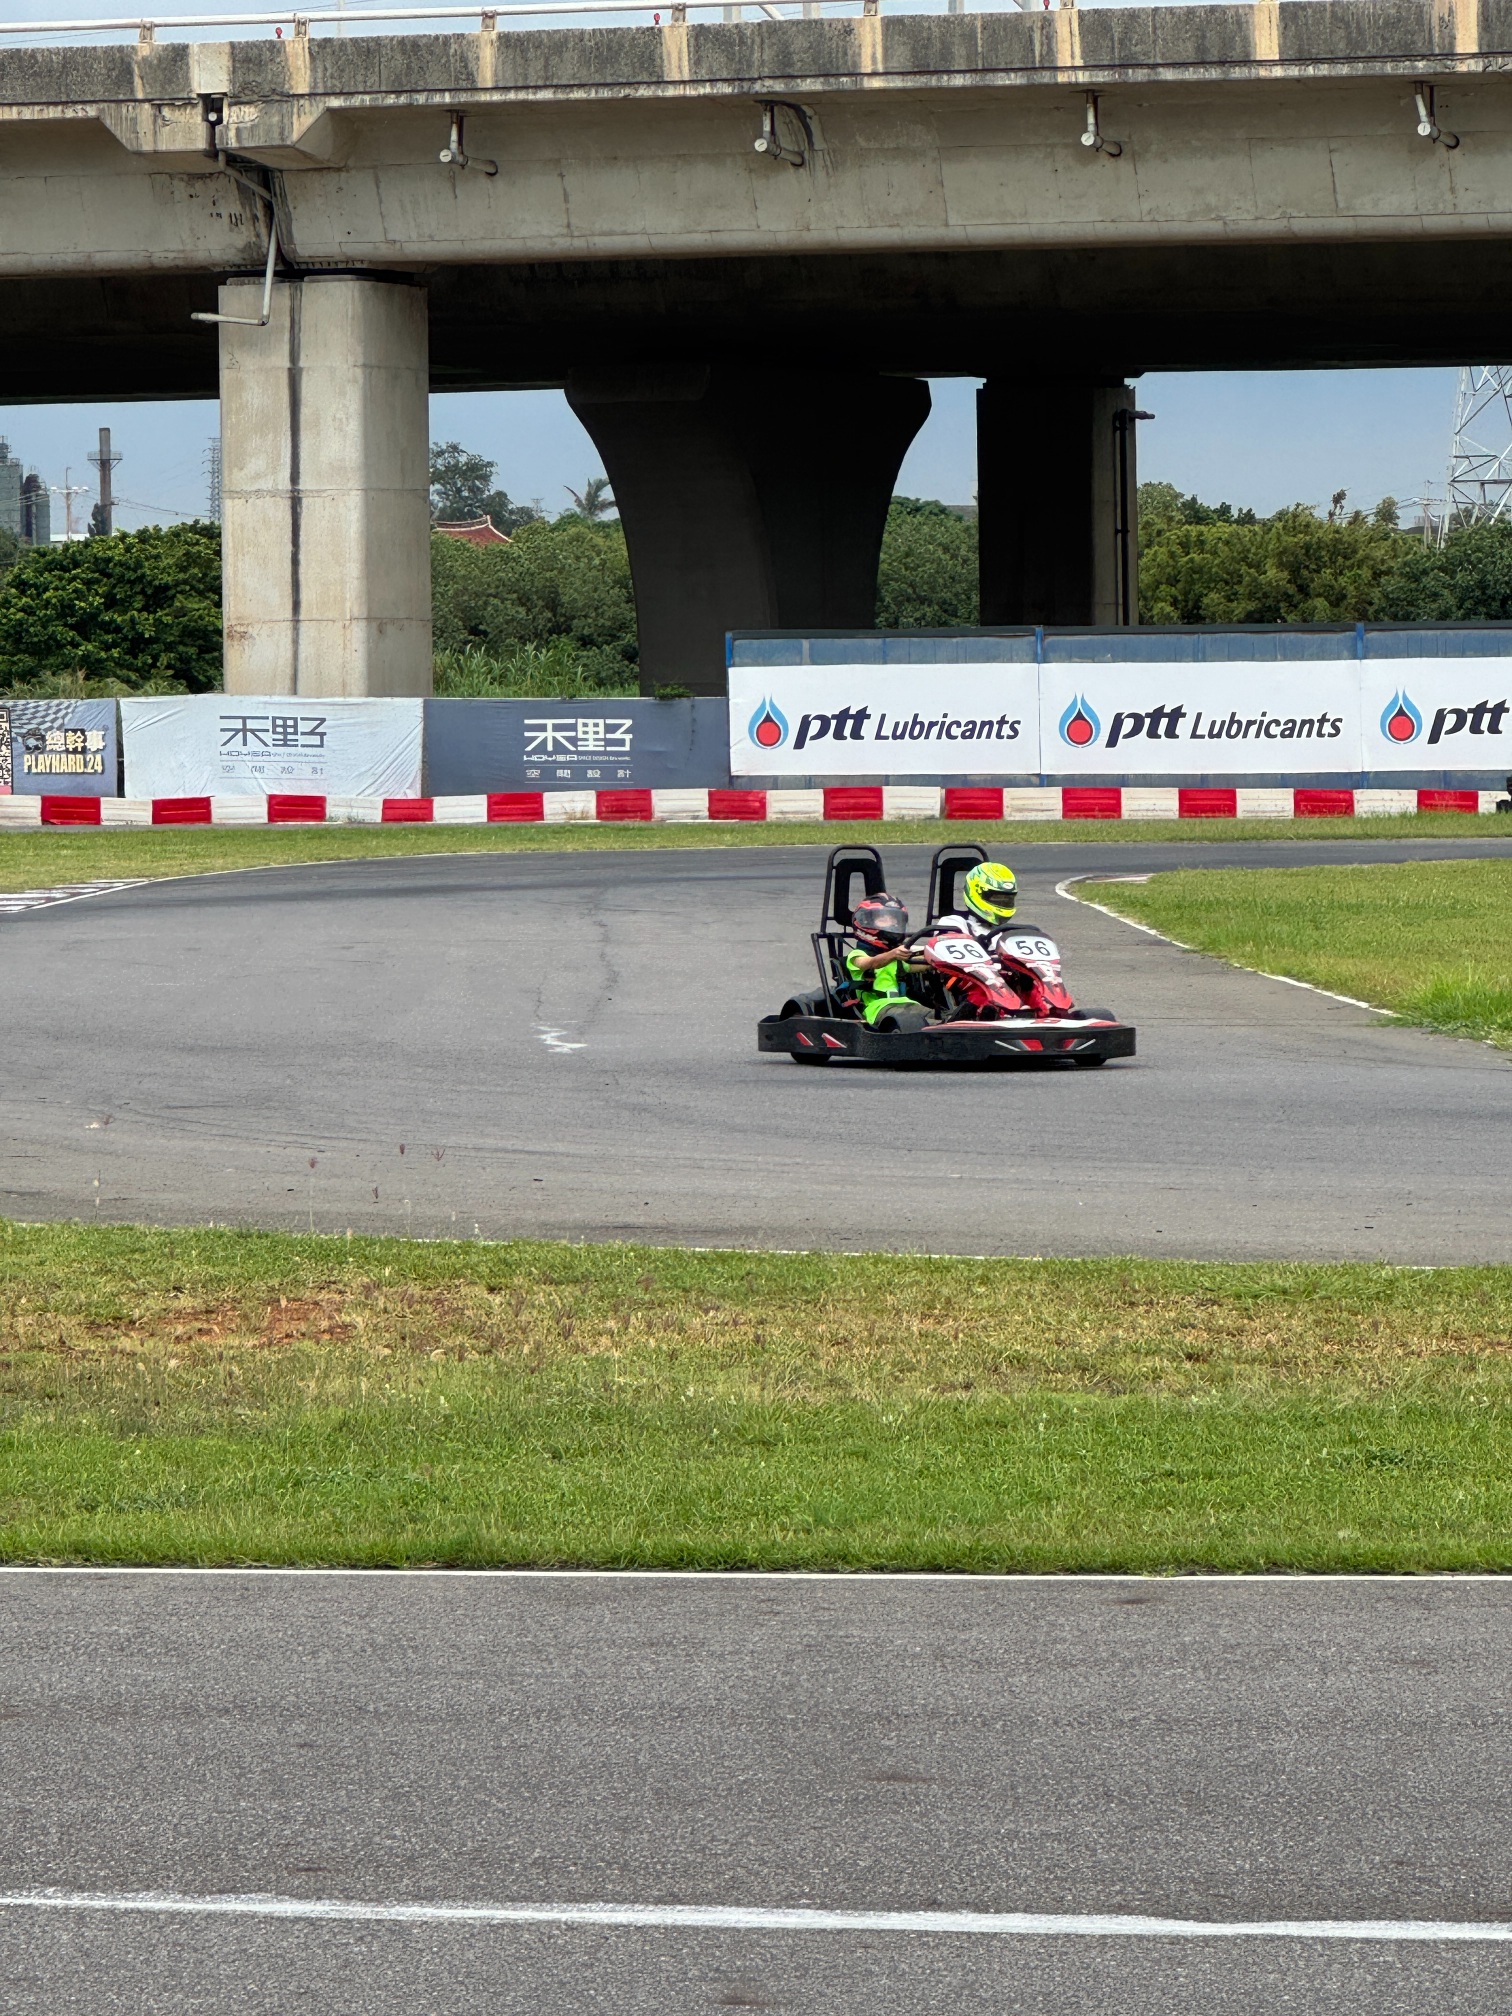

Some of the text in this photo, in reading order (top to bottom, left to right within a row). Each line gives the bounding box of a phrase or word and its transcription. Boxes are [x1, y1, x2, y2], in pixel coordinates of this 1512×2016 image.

[219, 715, 327, 748] 禾野
[523, 718, 633, 751] 禾野
[793, 705, 1021, 750] ptt Lubricants
[1105, 704, 1343, 749] ptt Lubricants
[1427, 698, 1510, 745] ptt
[23, 754, 103, 773] PLAYHARD.24
[945, 943, 983, 960] 56
[1015, 940, 1051, 957] 56
